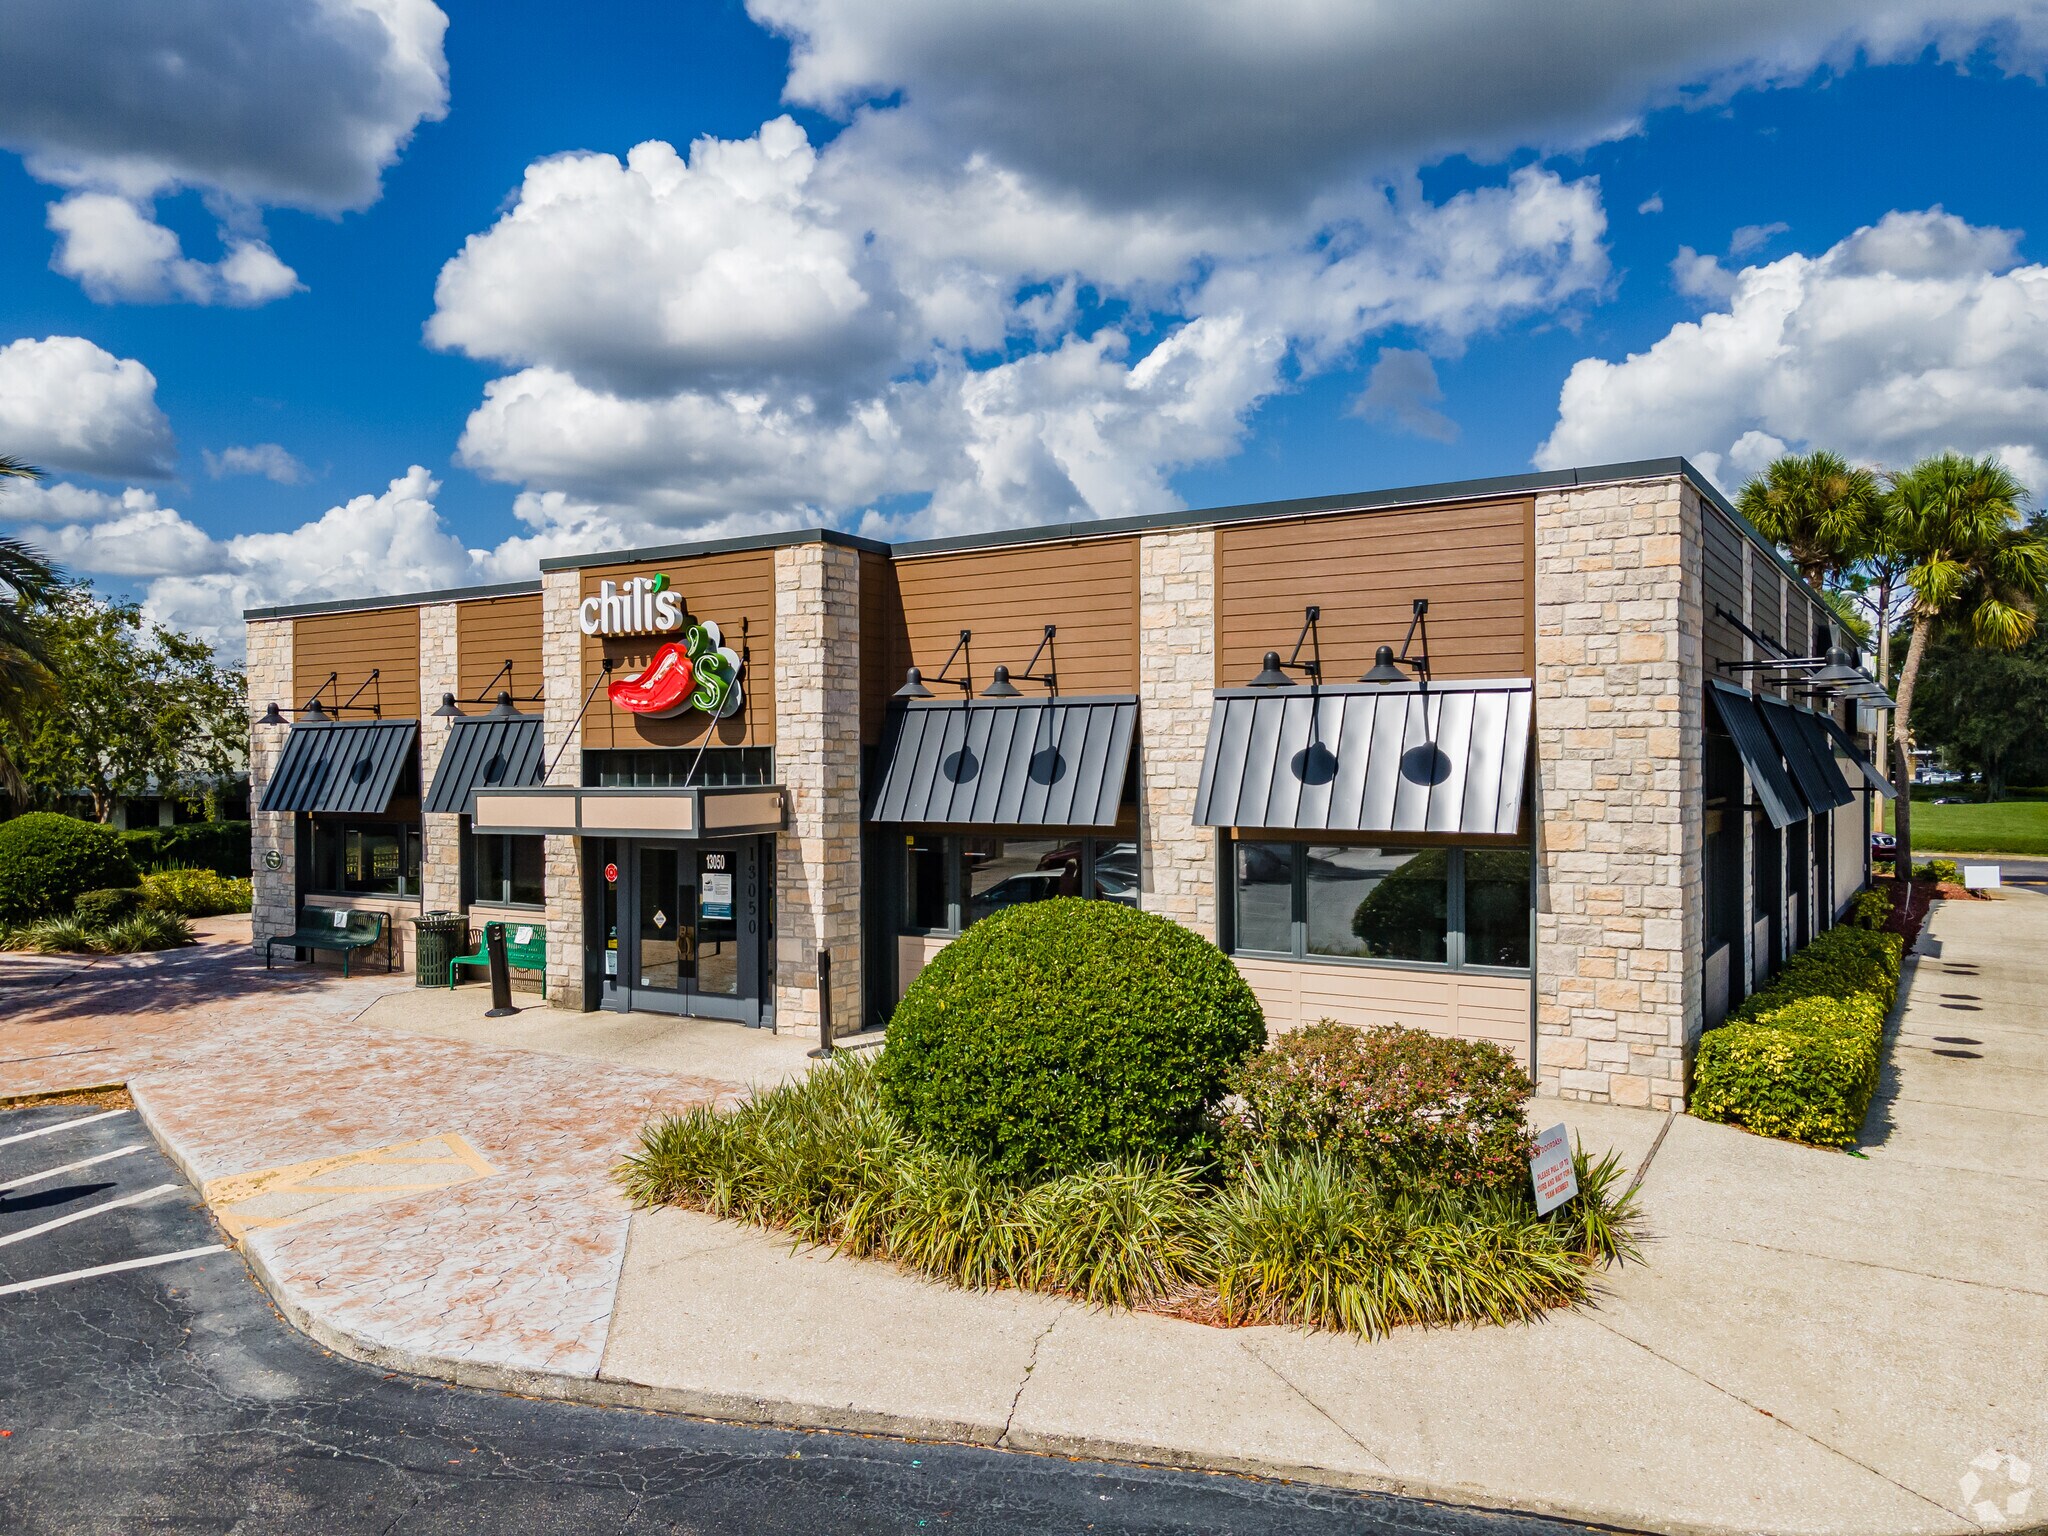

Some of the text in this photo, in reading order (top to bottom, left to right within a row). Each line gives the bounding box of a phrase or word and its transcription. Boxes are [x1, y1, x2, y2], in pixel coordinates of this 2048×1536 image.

[580, 573, 684, 635] chili's
[706, 854, 726, 870] 13050
[748, 847, 756, 934] 13050
[1537, 1158, 1569, 1181] PLEASE PULL UP TO
[1547, 1177, 1555, 1187] AND
[1555, 1172, 1563, 1183] WAIT
[1562, 1168, 1570, 1177] FOR
[1545, 1181, 1569, 1200] TEAM MEMBER
